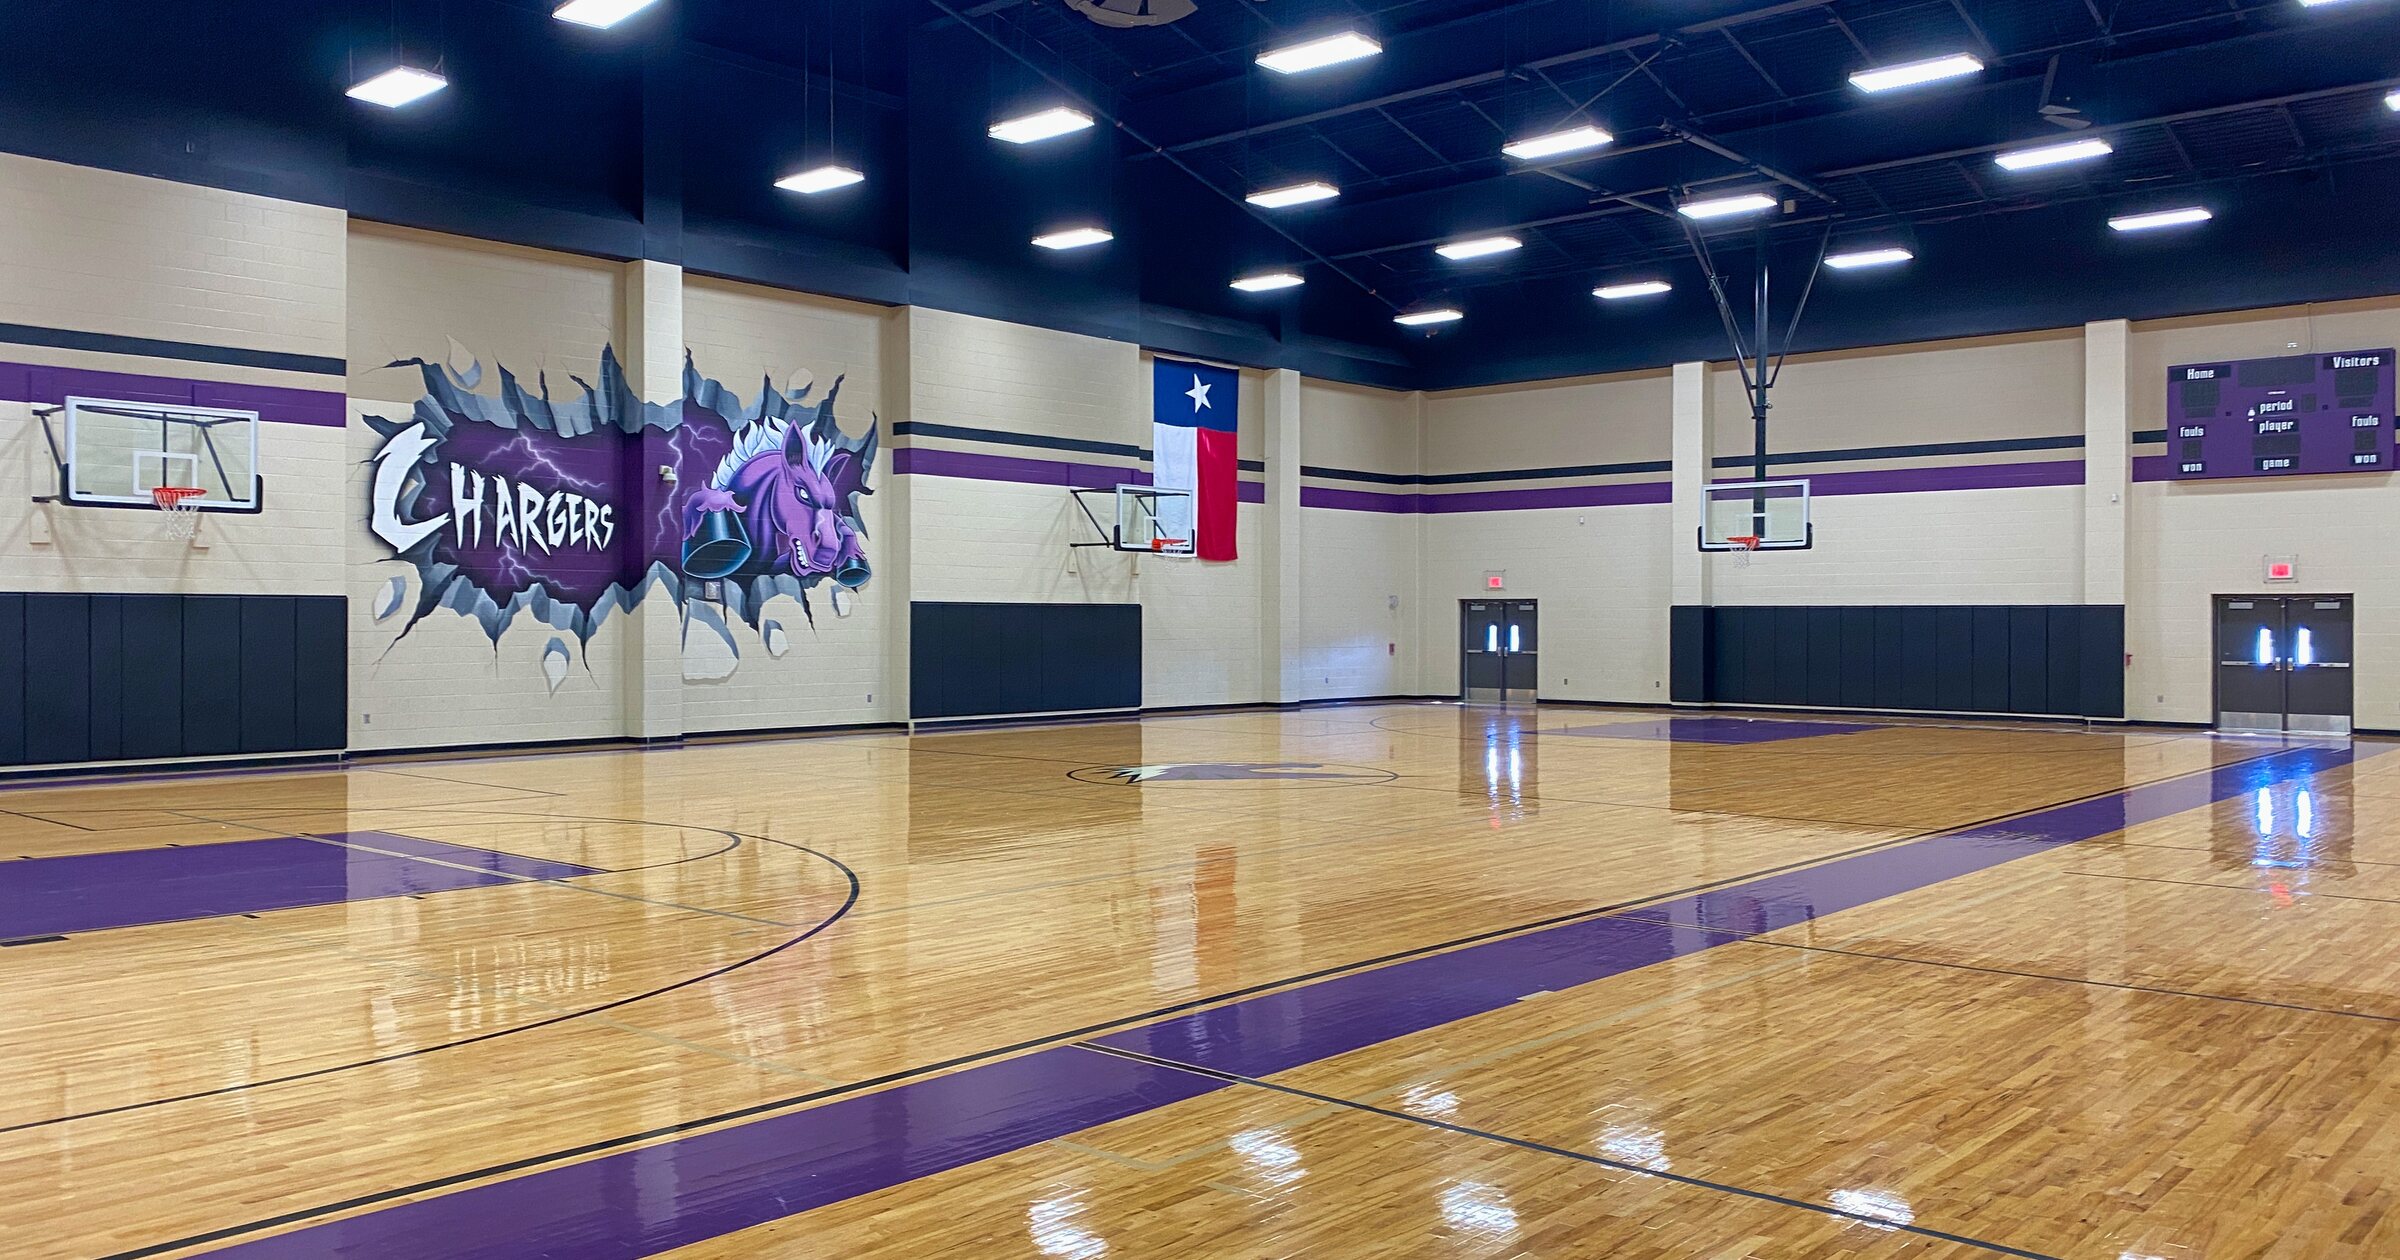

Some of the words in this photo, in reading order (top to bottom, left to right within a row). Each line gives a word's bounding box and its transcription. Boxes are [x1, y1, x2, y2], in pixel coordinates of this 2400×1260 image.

[2333, 356, 2379, 369] Visitors
[2187, 368, 2214, 380] Home
[2260, 399, 2293, 415] period
[2259, 420, 2294, 434] player
[2352, 415, 2379, 427] fouls
[2180, 426, 2204, 437] fouls
[2262, 458, 2290, 471] game
[2354, 454, 2377, 464] won
[2182, 463, 2203, 472] won
[371, 422, 615, 556] CHARGERS
